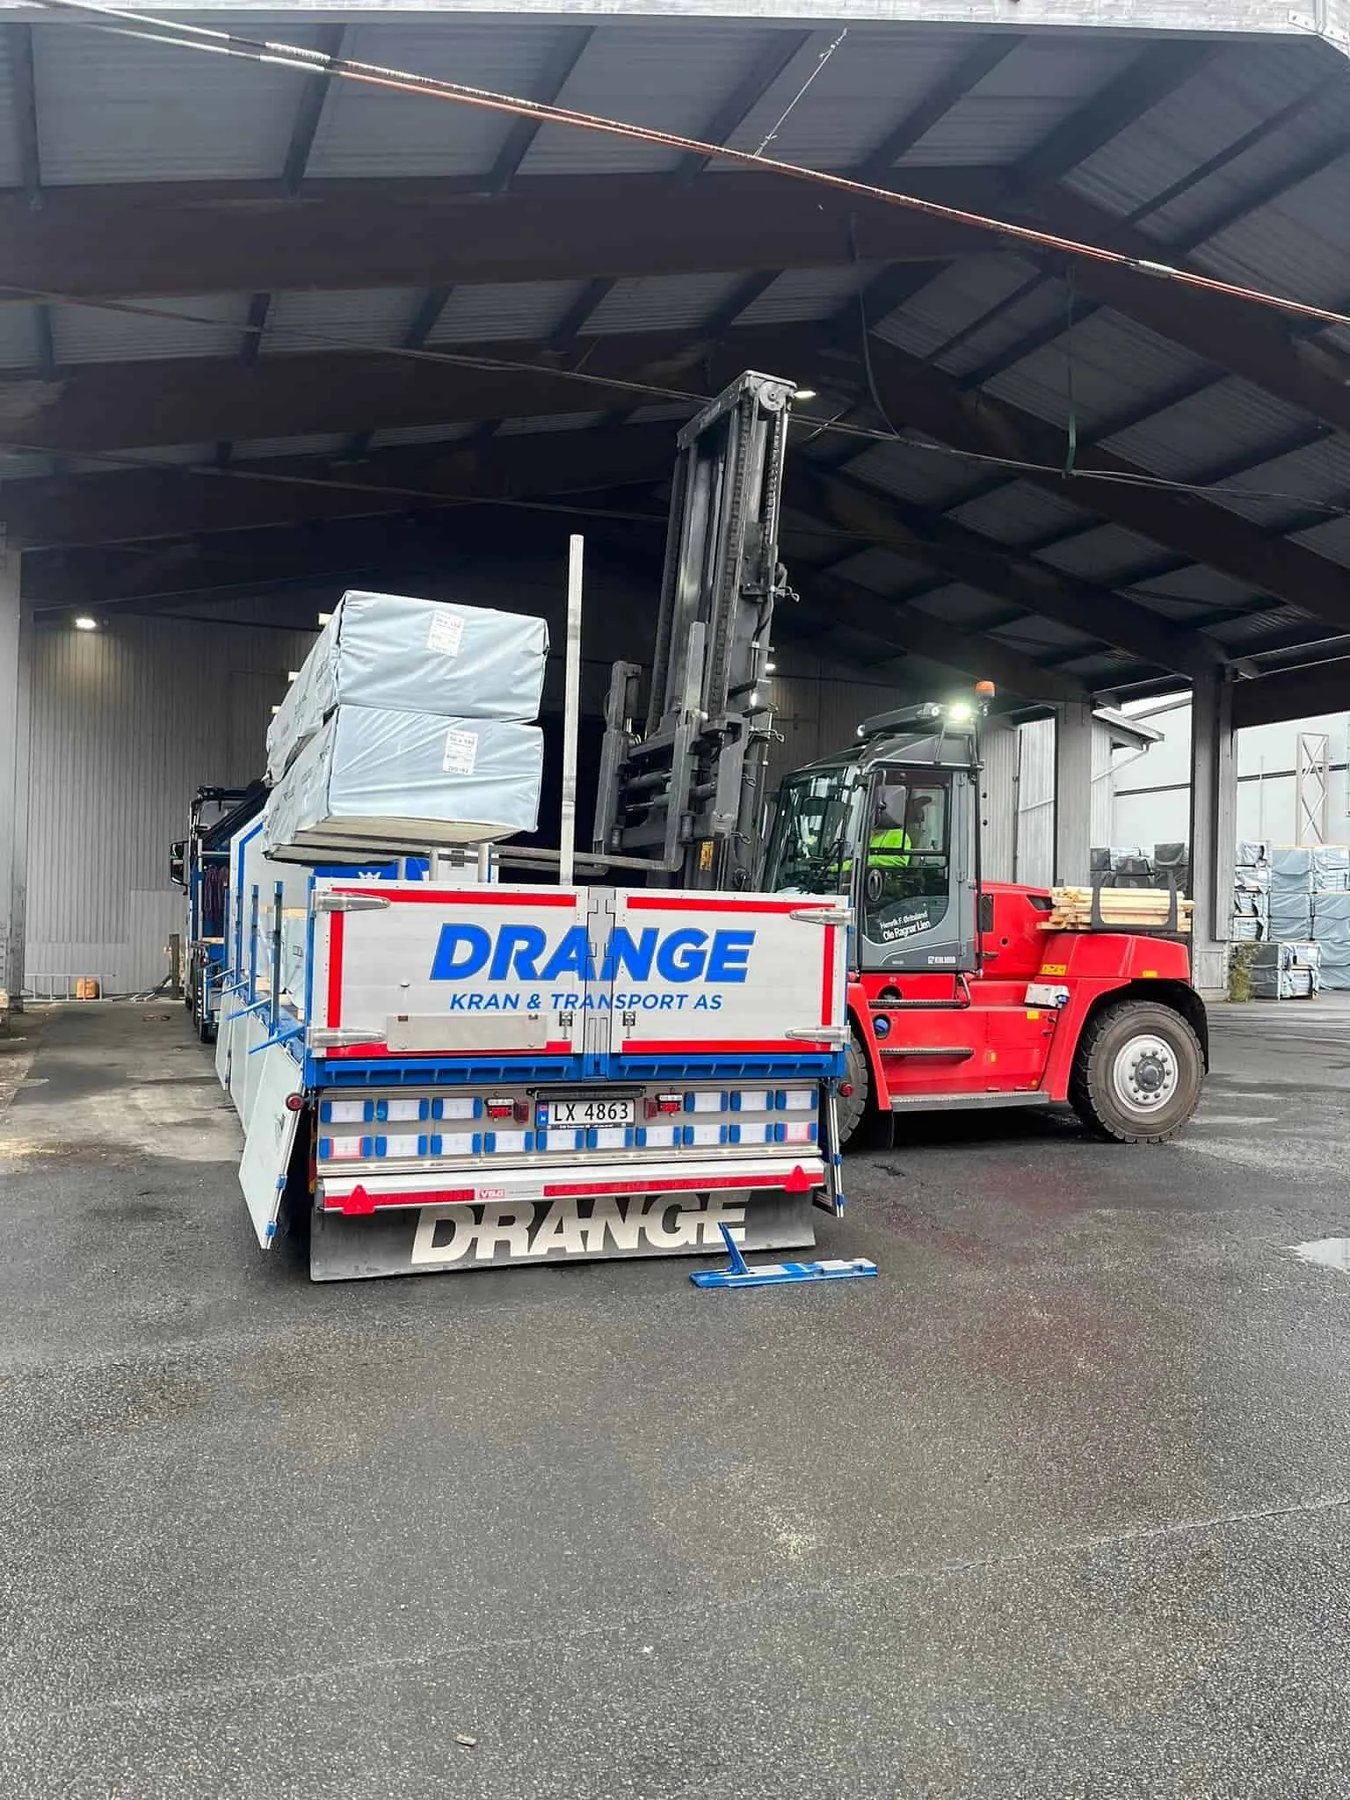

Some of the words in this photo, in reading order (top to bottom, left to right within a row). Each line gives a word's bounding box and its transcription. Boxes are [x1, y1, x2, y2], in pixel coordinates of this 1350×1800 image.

[895, 924, 917, 937] Ragnar
[429, 922, 757, 983] DRANGE
[450, 992, 519, 1010] KRAN
[527, 993, 542, 1009] &
[551, 993, 691, 1010] TRANSPORT
[693, 993, 723, 1010] AS
[554, 1103, 576, 1122] LX
[584, 1101, 628, 1121] 4863
[411, 1191, 752, 1264] DRANGE
